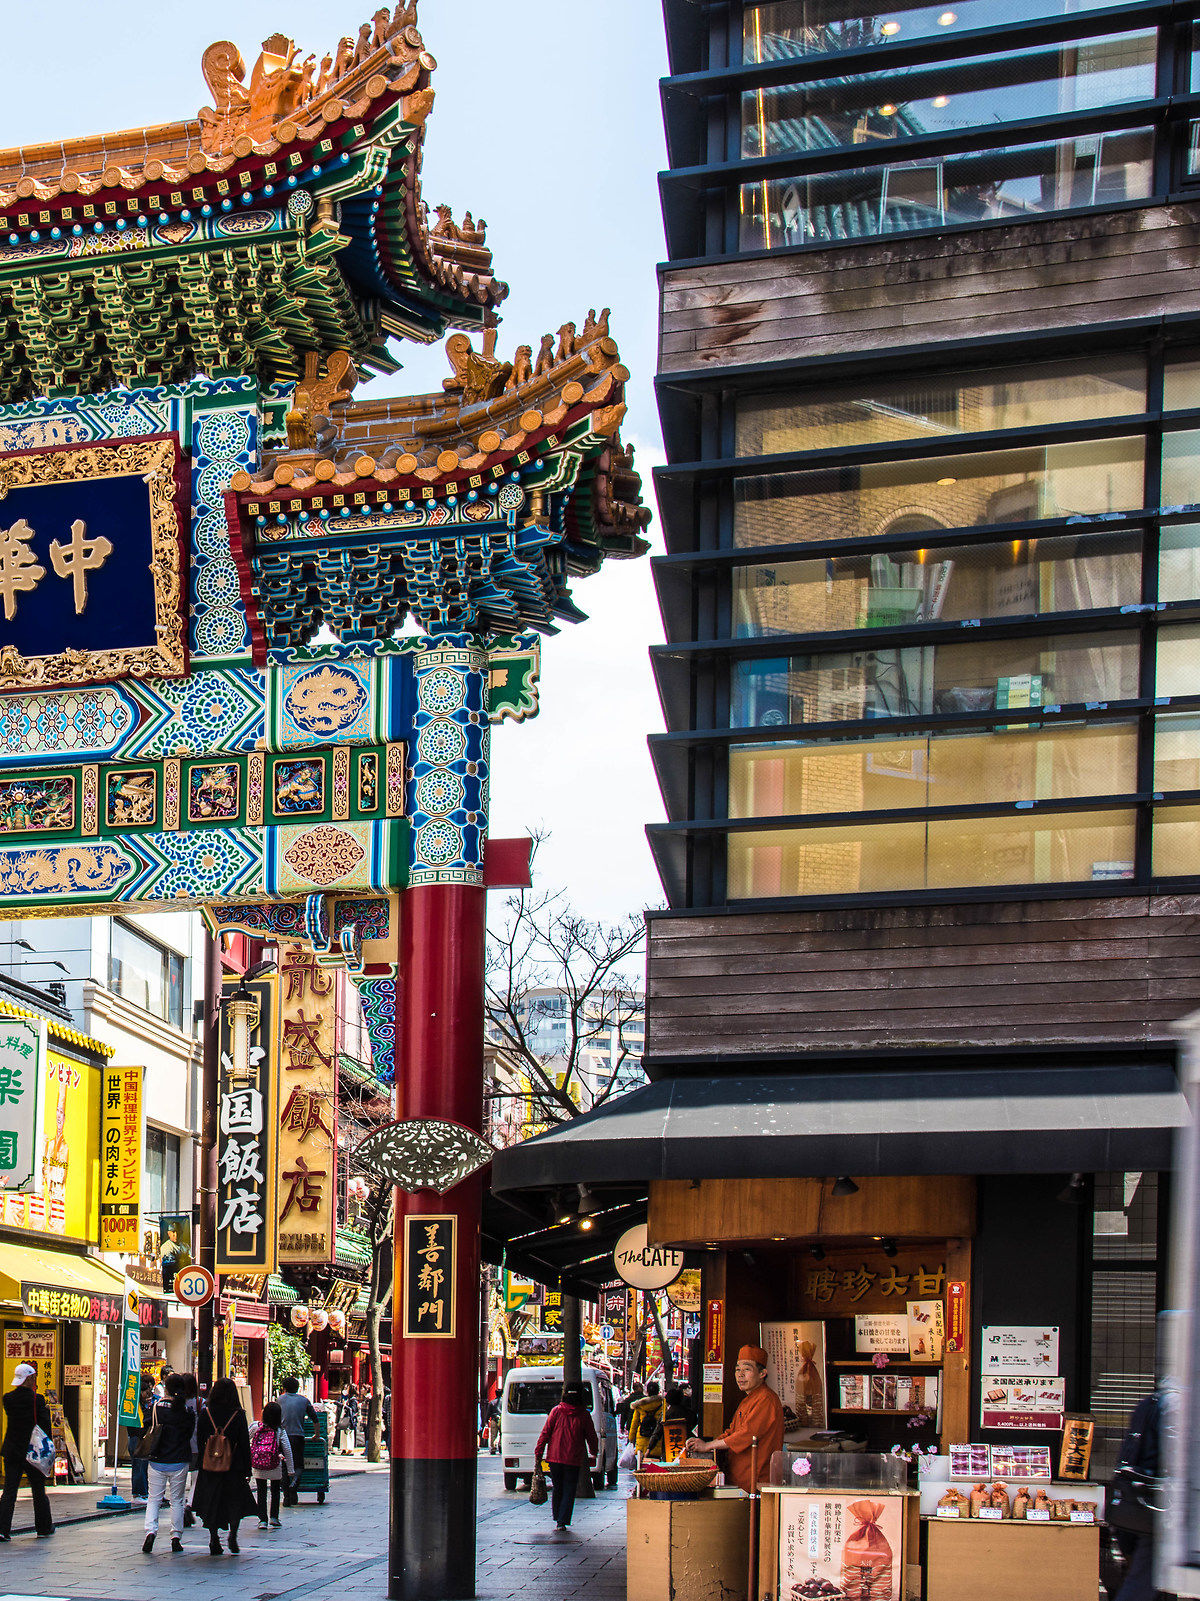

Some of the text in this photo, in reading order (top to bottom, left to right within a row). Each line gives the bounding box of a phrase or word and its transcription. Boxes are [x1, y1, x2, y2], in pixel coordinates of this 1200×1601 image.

[280, 946, 334, 1223] 龍盛飯店
[105, 1074, 122, 1197] 世界一の肉まん
[122, 1070, 139, 1201] 中国料理世界チャンピオン
[110, 1204, 130, 1215] 1個
[102, 1217, 137, 1234] 100円
[618, 1247, 679, 1267] The CAFE
[183, 1278, 205, 1296] 30
[28, 1289, 120, 1323] 中華街名物の肉まん
[7, 1341, 54, 1357] 第1位!!
